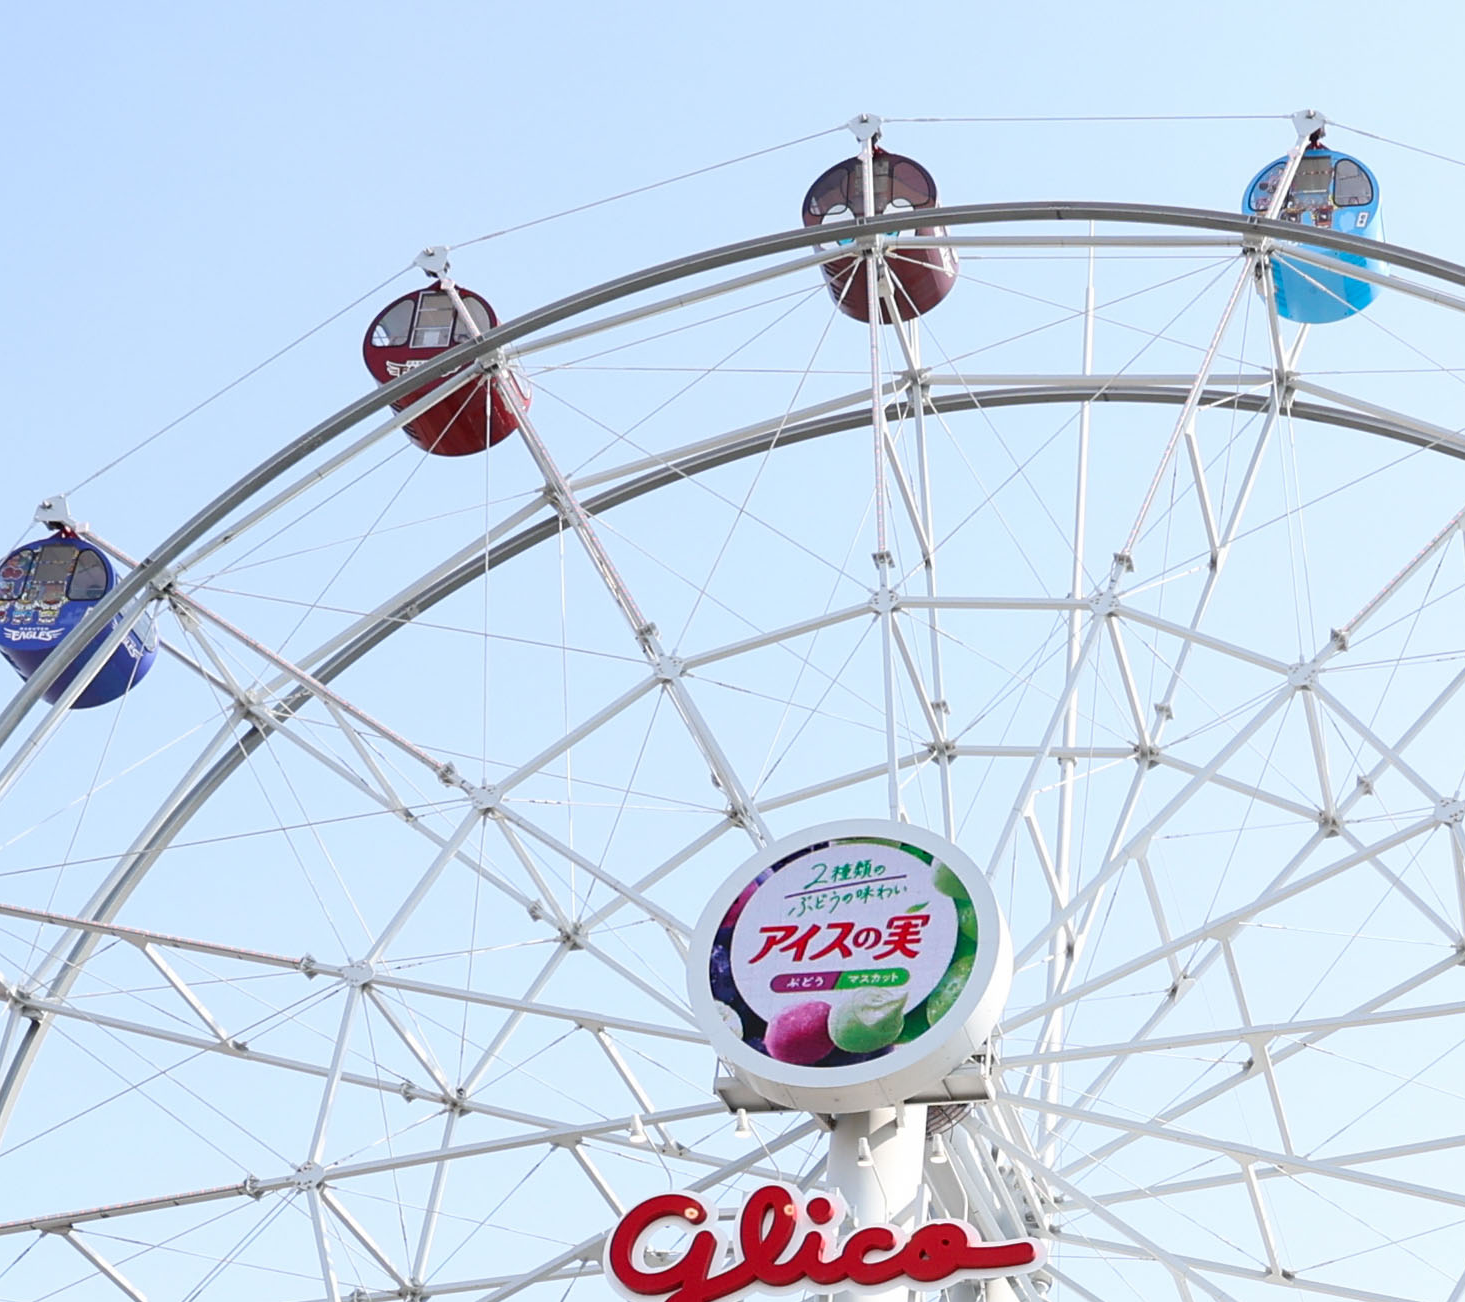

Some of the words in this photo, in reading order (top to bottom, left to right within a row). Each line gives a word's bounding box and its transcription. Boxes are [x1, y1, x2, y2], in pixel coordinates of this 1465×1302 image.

[10, 630, 54, 641] EAGLES
[803, 858, 886, 889] 2種類の
[787, 885, 908, 917] ぶどうの味わい
[748, 913, 931, 964] アイスの実
[786, 975, 825, 988] ぶどう
[847, 973, 899, 984] マスカット
